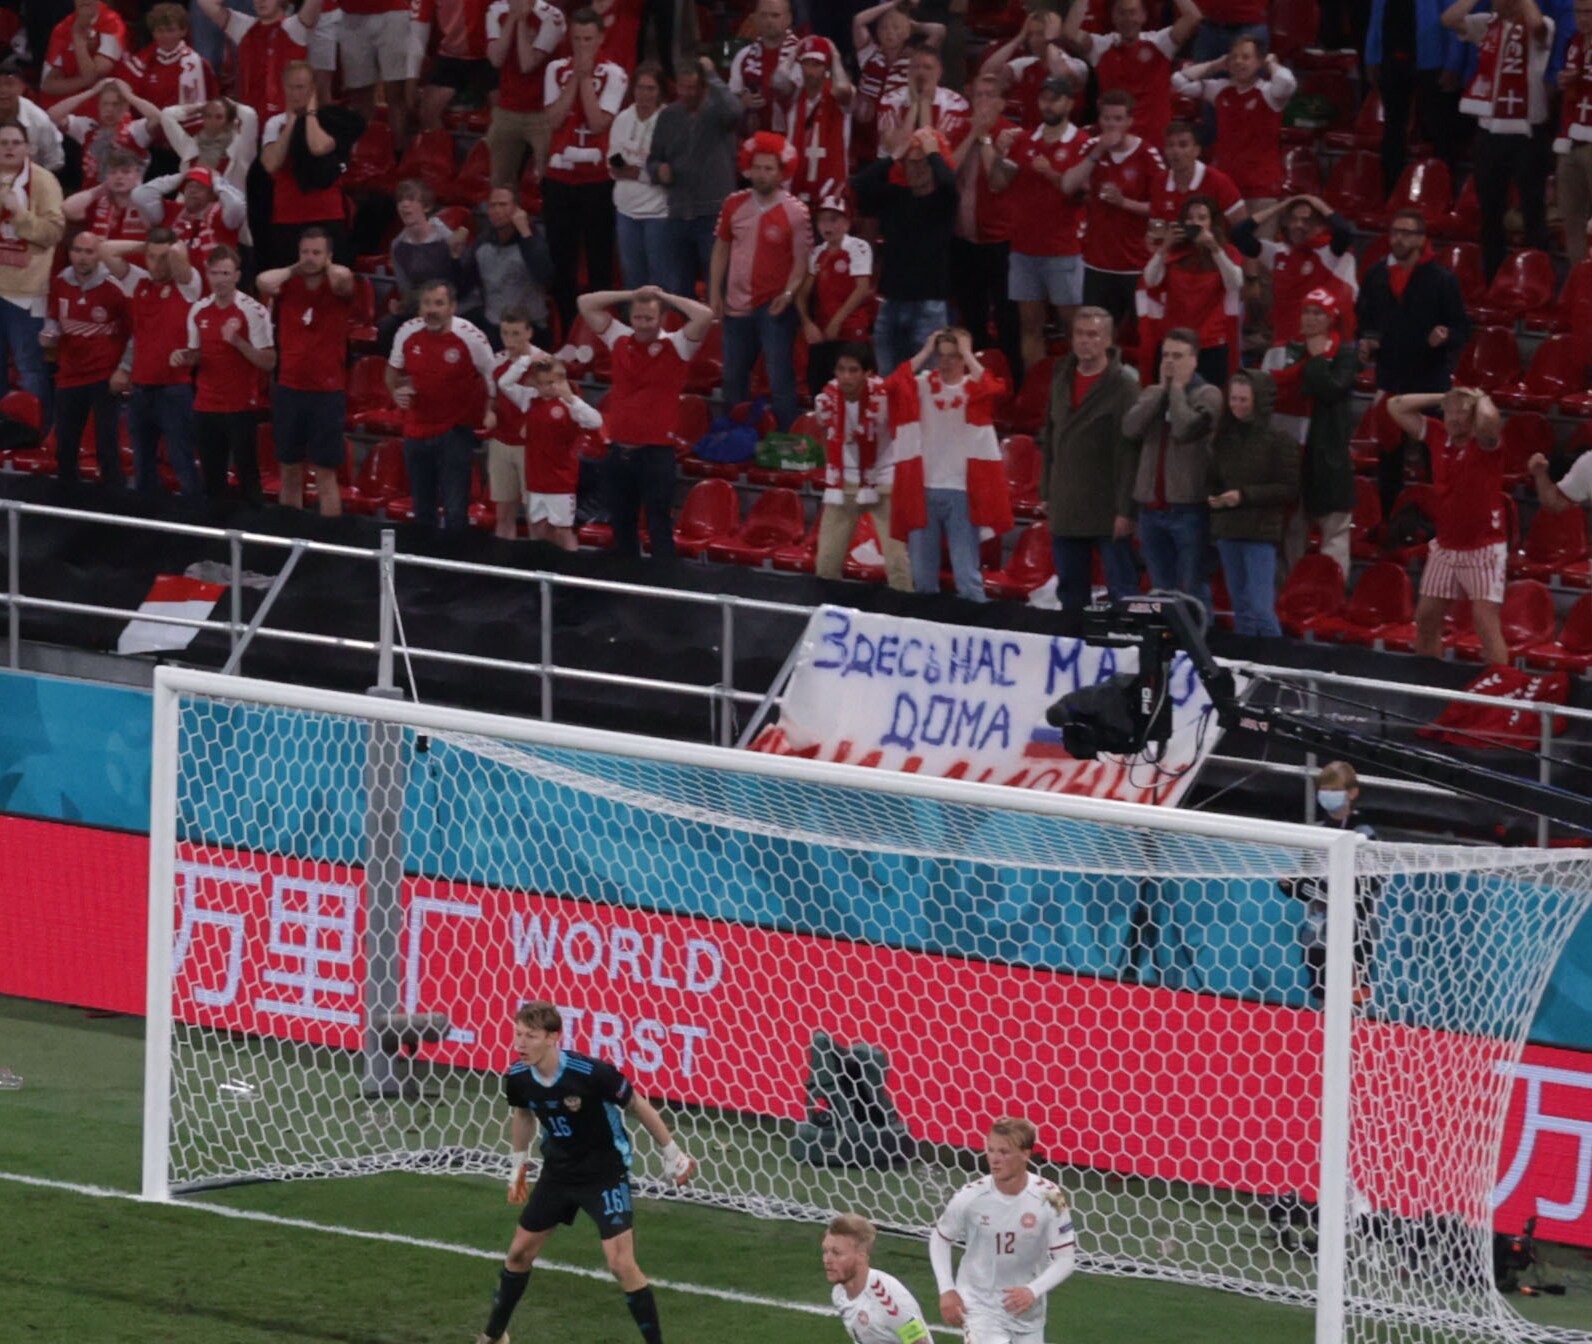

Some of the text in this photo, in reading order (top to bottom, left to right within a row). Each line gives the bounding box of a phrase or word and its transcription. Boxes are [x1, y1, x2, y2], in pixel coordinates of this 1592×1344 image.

[881, 690, 1011, 752] ДОМА
[513, 910, 724, 995] WORLD
[517, 999, 709, 1078] IRST
[548, 1115, 573, 1138] 16
[601, 1189, 625, 1215] 16
[994, 1231, 1017, 1256] 12
